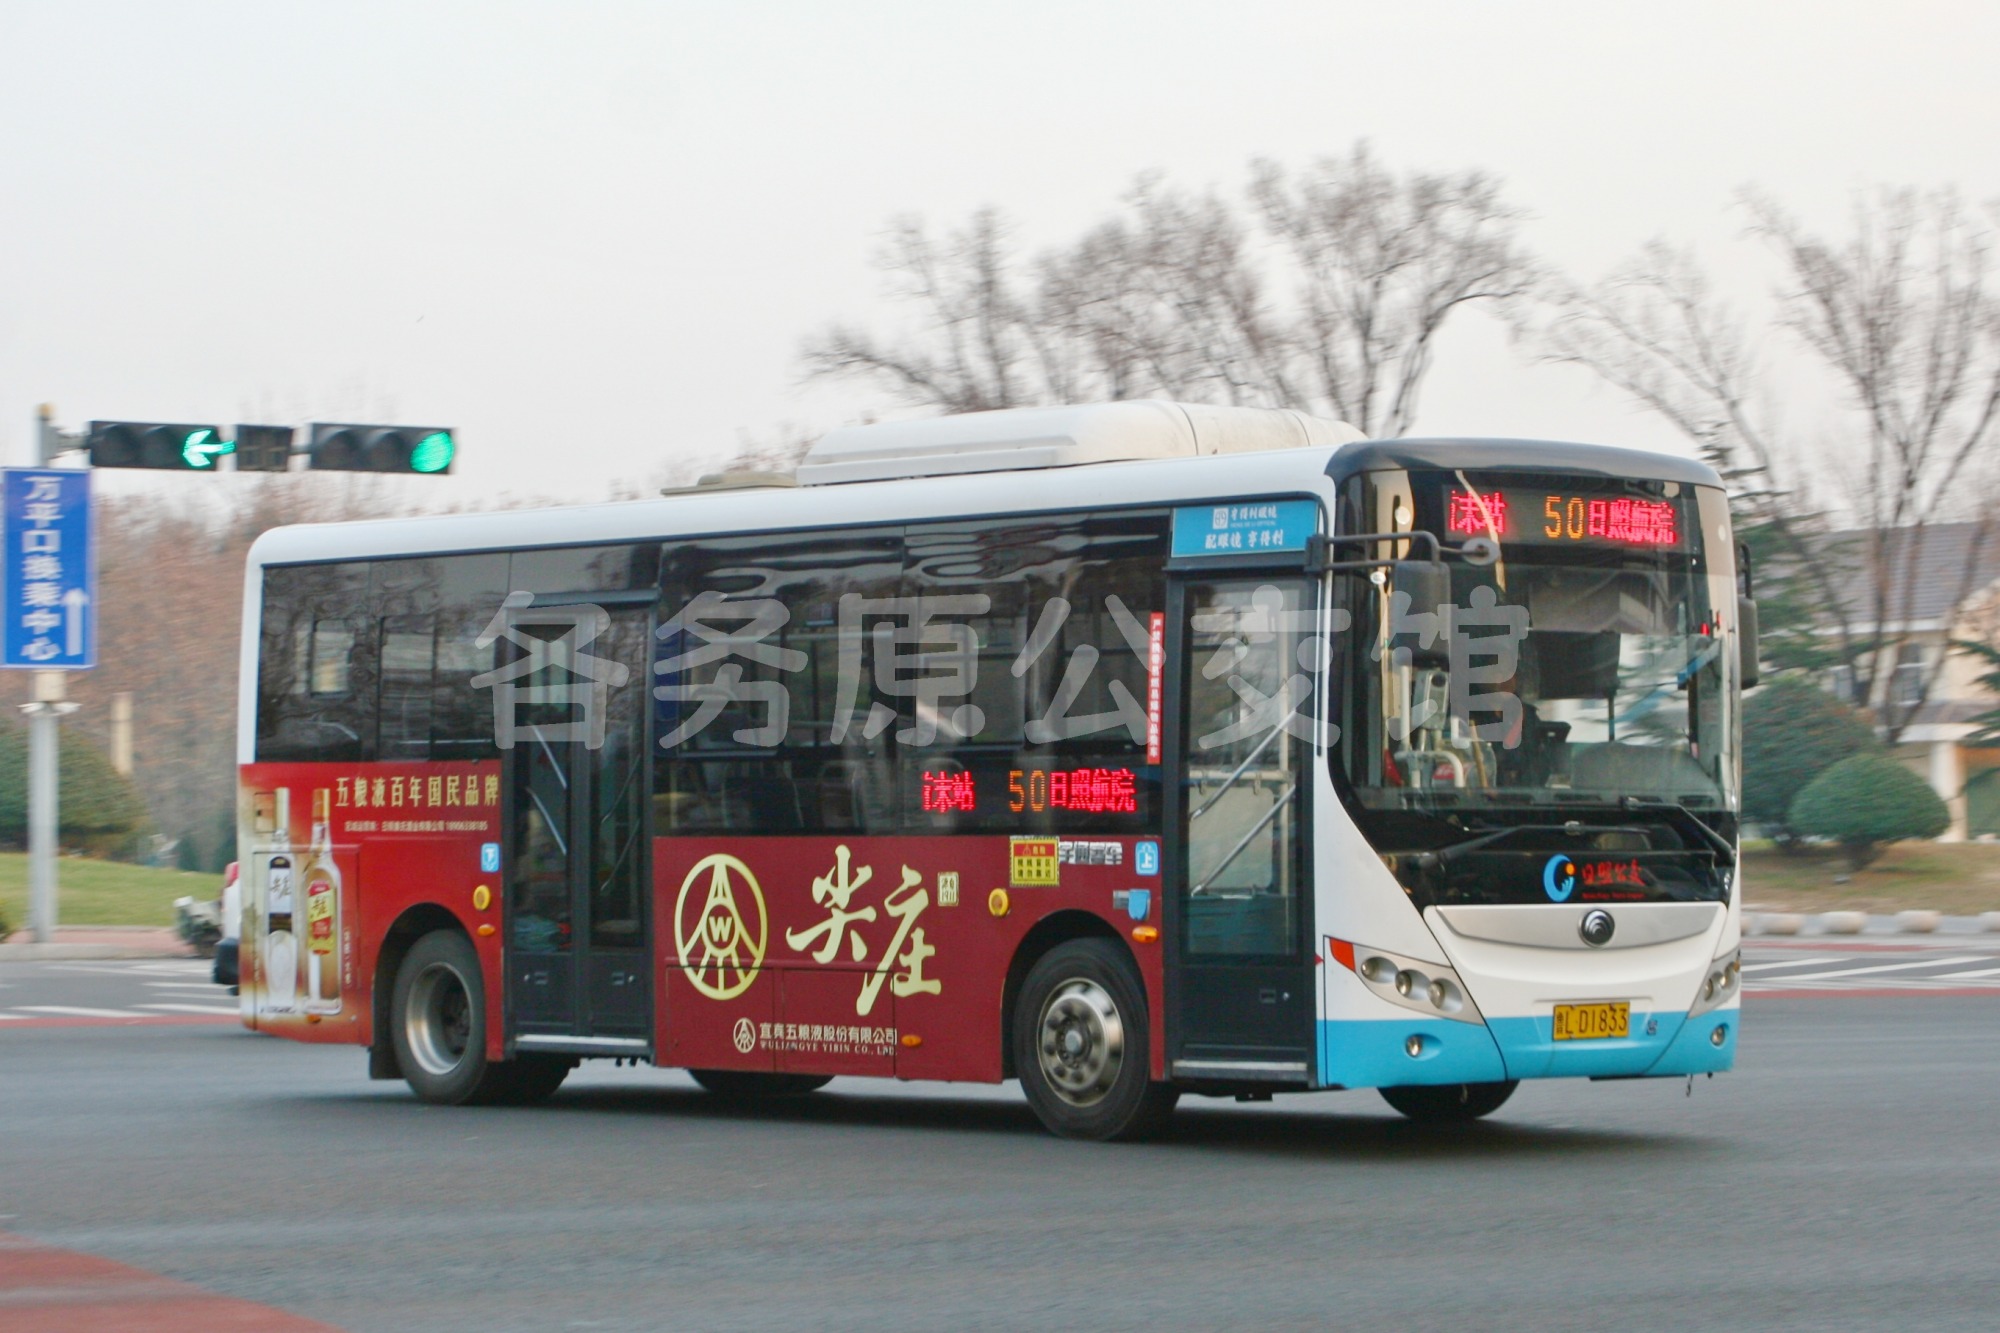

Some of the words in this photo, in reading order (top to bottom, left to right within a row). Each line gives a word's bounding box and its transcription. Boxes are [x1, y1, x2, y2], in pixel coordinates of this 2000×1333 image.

[1545, 496, 1584, 539] 50
[21, 475, 65, 661] 万平口换乘中心
[335, 774, 500, 809] 五粮液百年国民品牌
[1008, 770, 1046, 812] 50
[784, 844, 944, 1016] 尖庄
[760, 1022, 897, 1045] 宜宾五粮液股份有限公司
